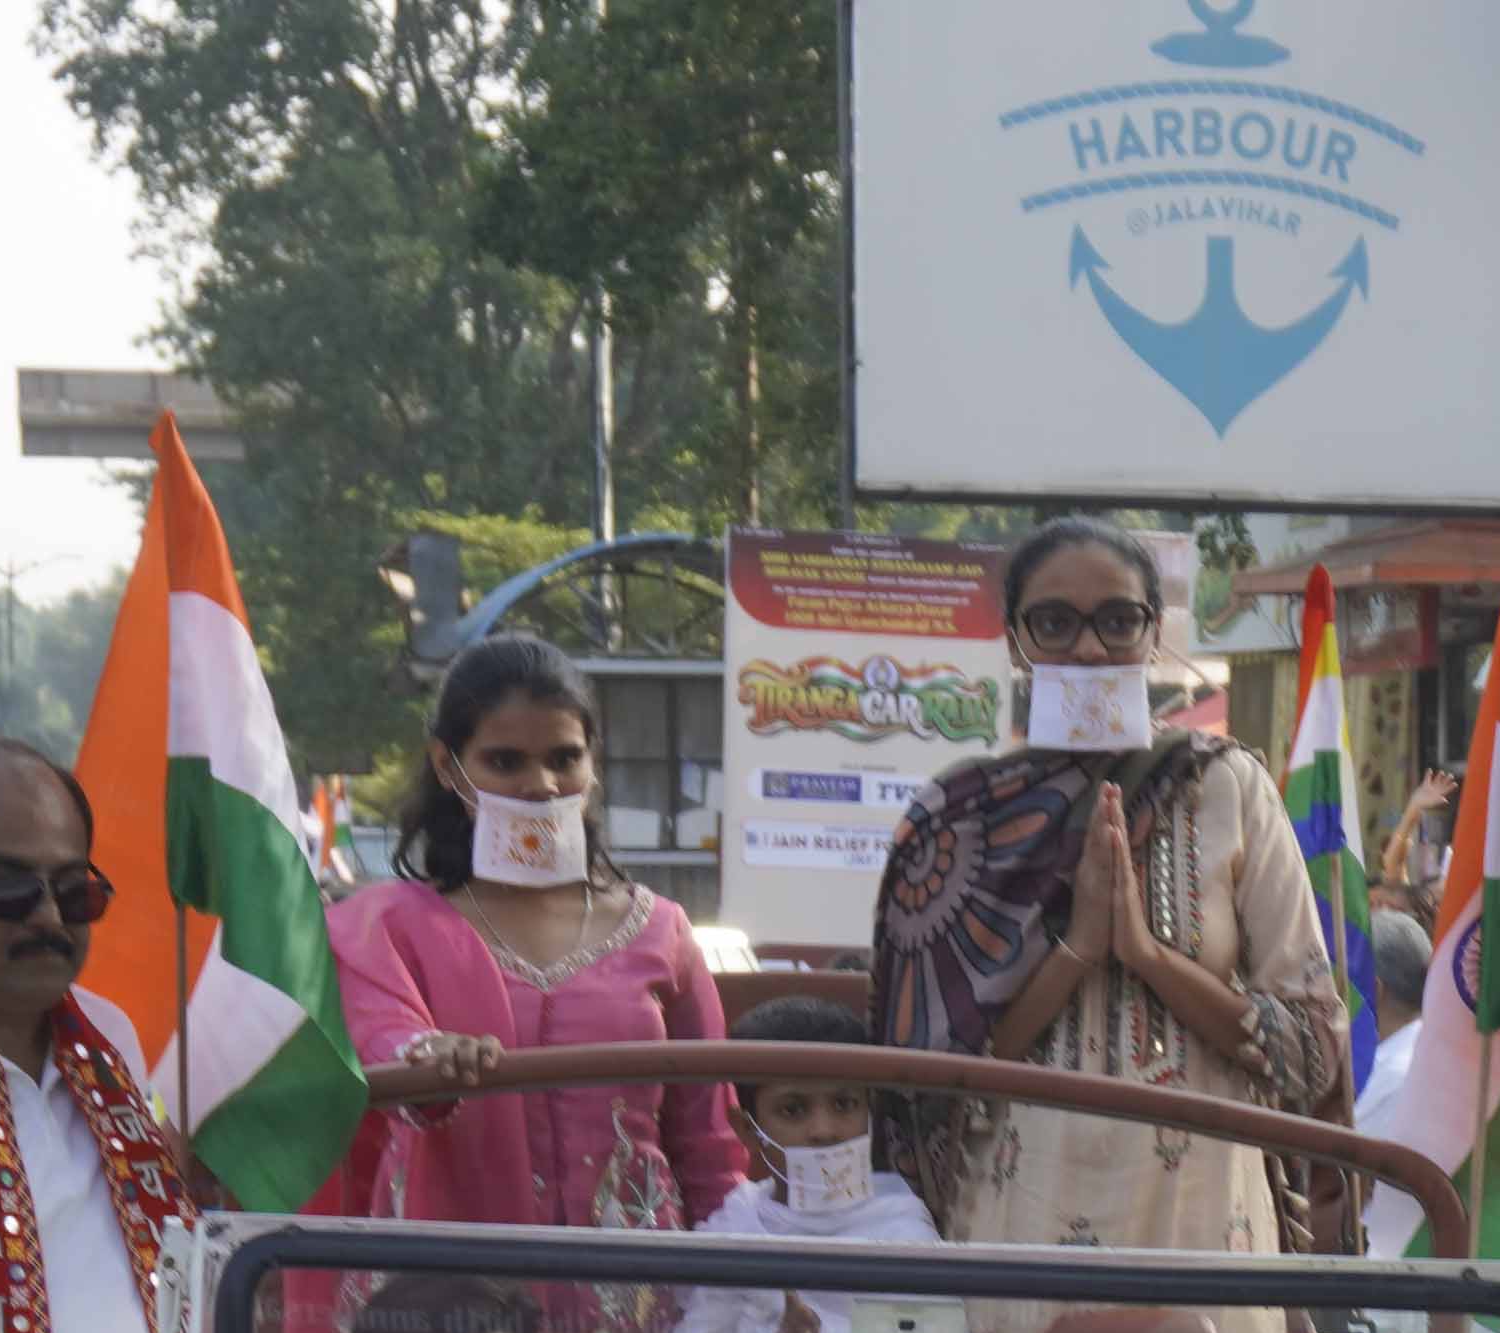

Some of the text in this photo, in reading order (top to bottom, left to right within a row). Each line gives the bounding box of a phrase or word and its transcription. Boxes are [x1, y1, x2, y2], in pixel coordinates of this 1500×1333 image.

[1069, 107, 1357, 183] HARBOUR
[1125, 195, 1302, 237] @JALAVIHAR
[742, 682, 998, 746] TIRANGA CAR RALLY
[771, 831, 807, 849] JAIN
[811, 834, 869, 851] RELIEF
